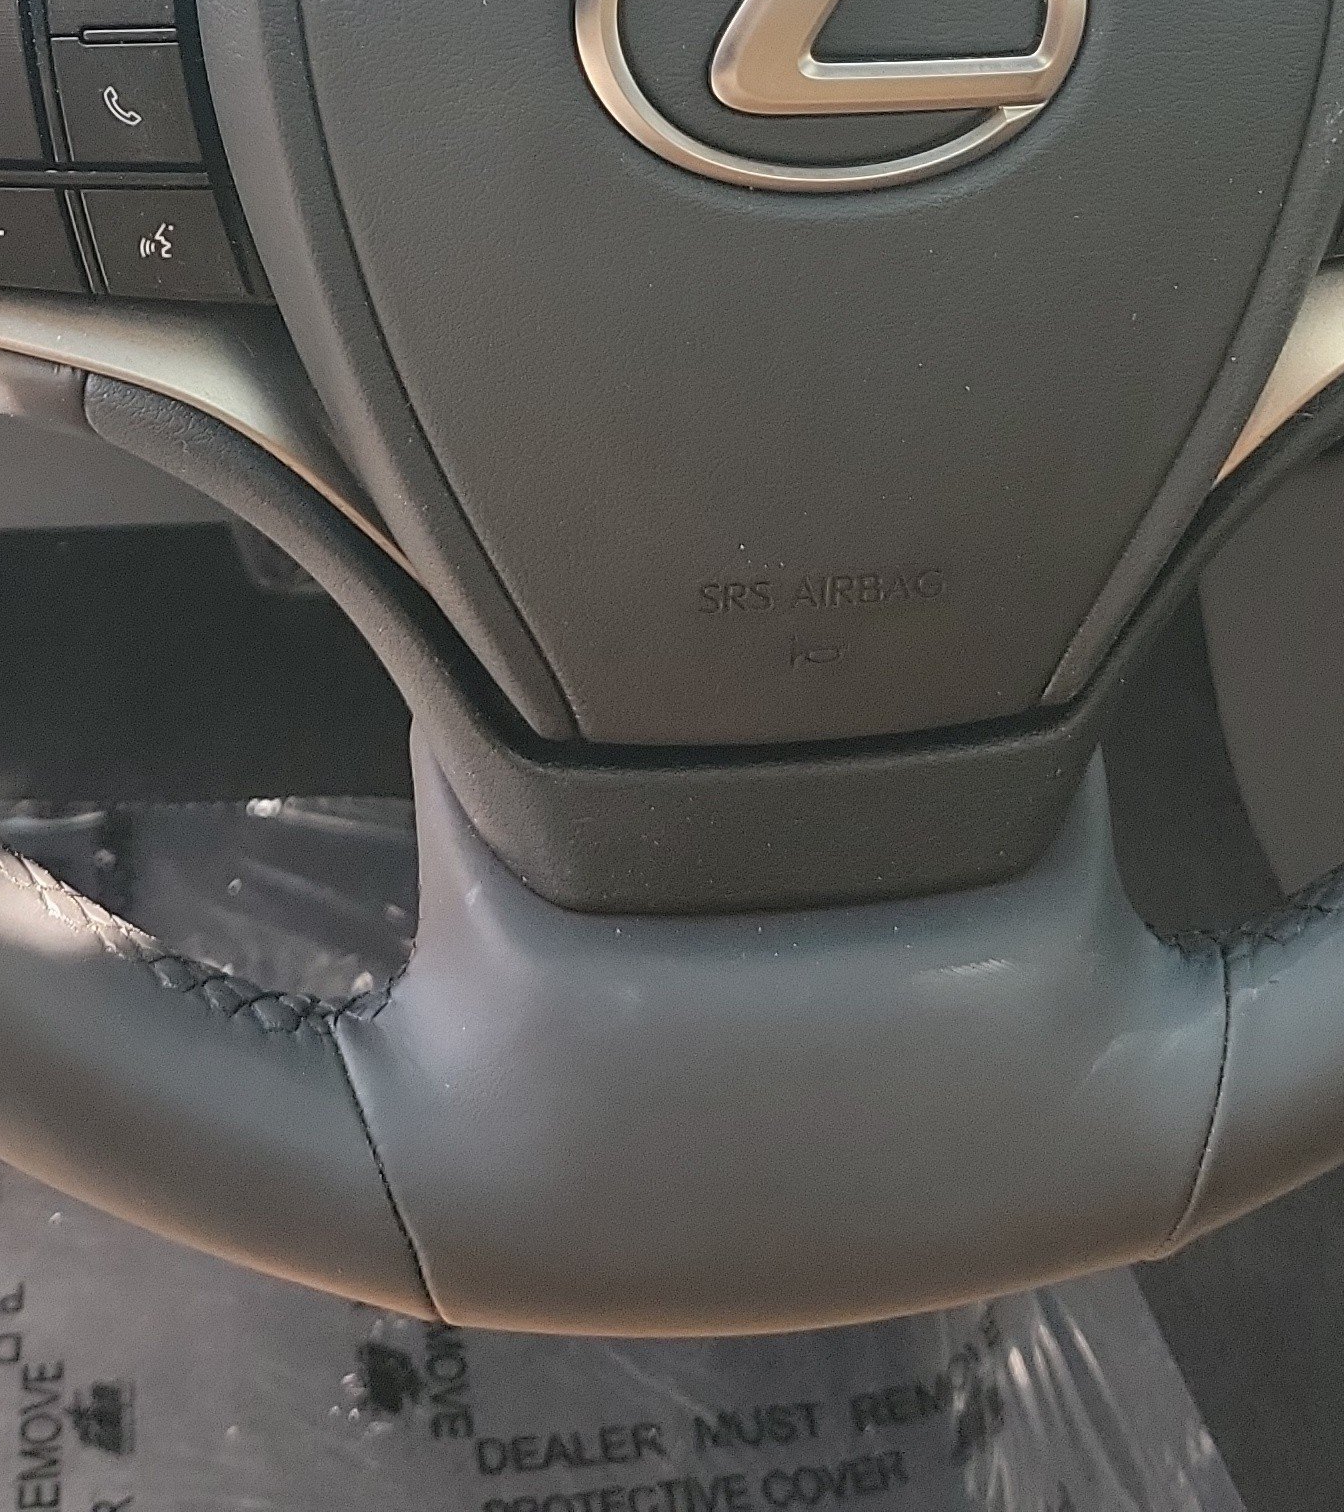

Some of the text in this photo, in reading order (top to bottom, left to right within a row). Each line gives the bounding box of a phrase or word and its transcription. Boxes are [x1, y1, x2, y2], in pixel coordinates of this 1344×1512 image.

[699, 570, 945, 614] SRS AIRBAG
[475, 1422, 668, 1477] DEALER
[692, 1401, 821, 1451] MUST
